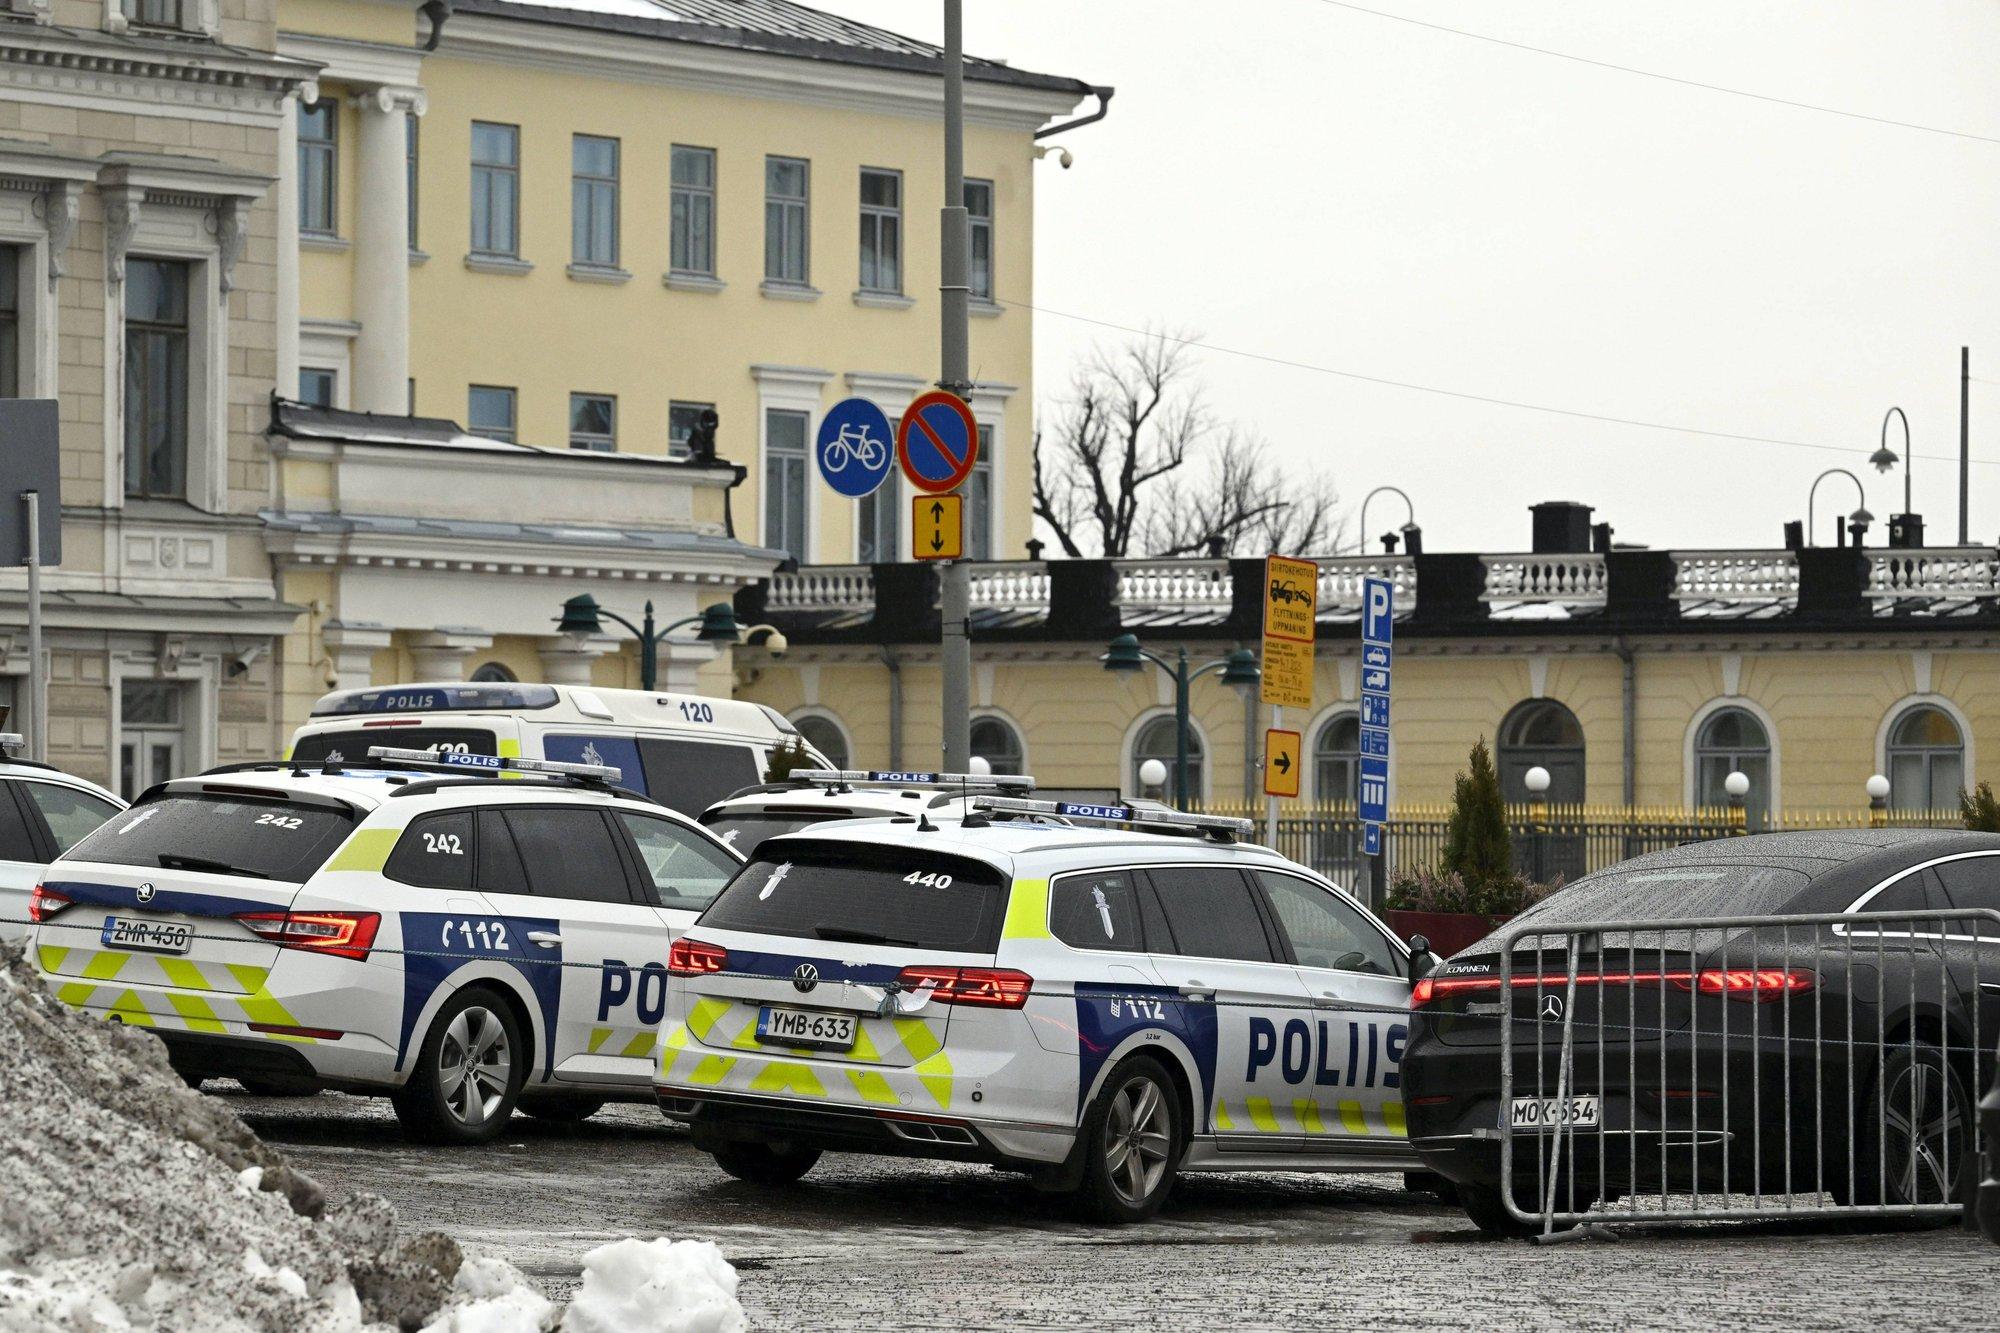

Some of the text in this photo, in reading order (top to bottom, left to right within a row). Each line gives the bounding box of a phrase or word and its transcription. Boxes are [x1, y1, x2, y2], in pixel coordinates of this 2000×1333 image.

[1271, 562, 1314, 578] SIIRTOKEHOTUS
[1369, 583, 1389, 637] P
[1272, 621, 1307, 635] UPPMANING
[386, 695, 434, 709] POLIS
[680, 701, 713, 723] 120
[448, 754, 499, 767] POLIS
[877, 772, 930, 782] POLIS
[1065, 805, 1123, 819] POLIS
[254, 813, 303, 830] 242
[422, 832, 464, 855] 242
[902, 870, 952, 890] 440
[459, 920, 510, 950] 112
[1446, 964, 1490, 974] KOVANEN
[1125, 994, 1165, 1020] 112
[773, 1012, 851, 1039] YMB-633
